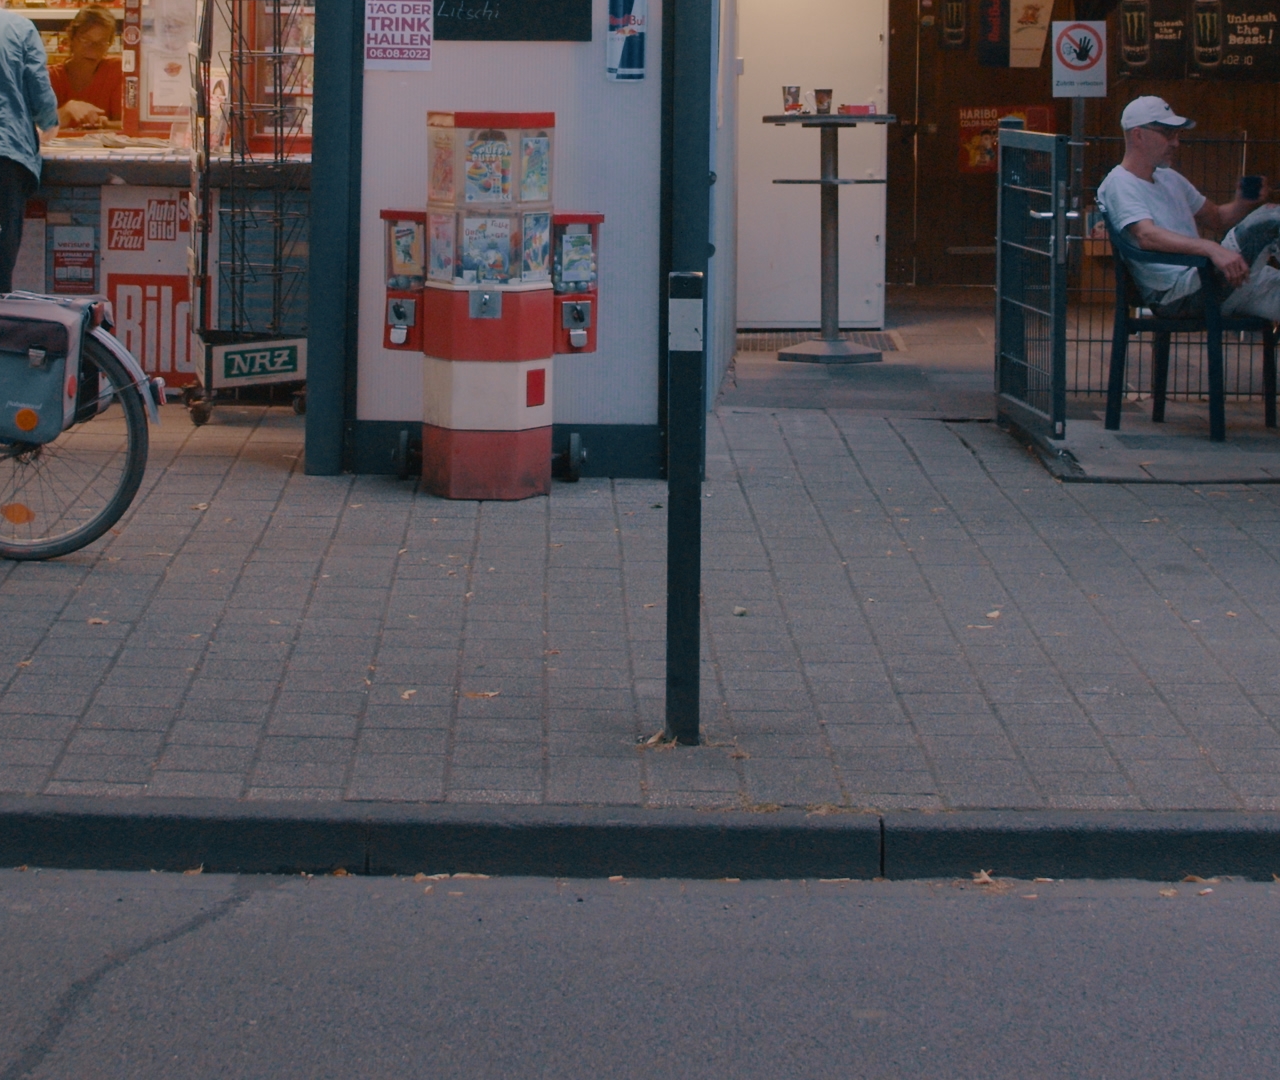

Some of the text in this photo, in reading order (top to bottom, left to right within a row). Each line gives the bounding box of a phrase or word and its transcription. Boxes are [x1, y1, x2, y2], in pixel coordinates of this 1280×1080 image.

[368, 3, 431, 15] TAG DER
[368, 16, 430, 32] TRINK
[1153, 19, 1183, 27] Unleash
[1227, 12, 1277, 24] Unleash
[1228, 29, 1273, 44] Beast!
[1237, 25, 1259, 35] the
[367, 33, 431, 46] HALLEN
[369, 48, 429, 59] 06.08.2022
[960, 109, 997, 119] HARIBO
[148, 201, 175, 220] Auto
[111, 211, 144, 229] Bild
[149, 221, 175, 239] Bild
[109, 230, 143, 248] Frau
[116, 285, 202, 373] Bild
[227, 350, 294, 375] NRZ
